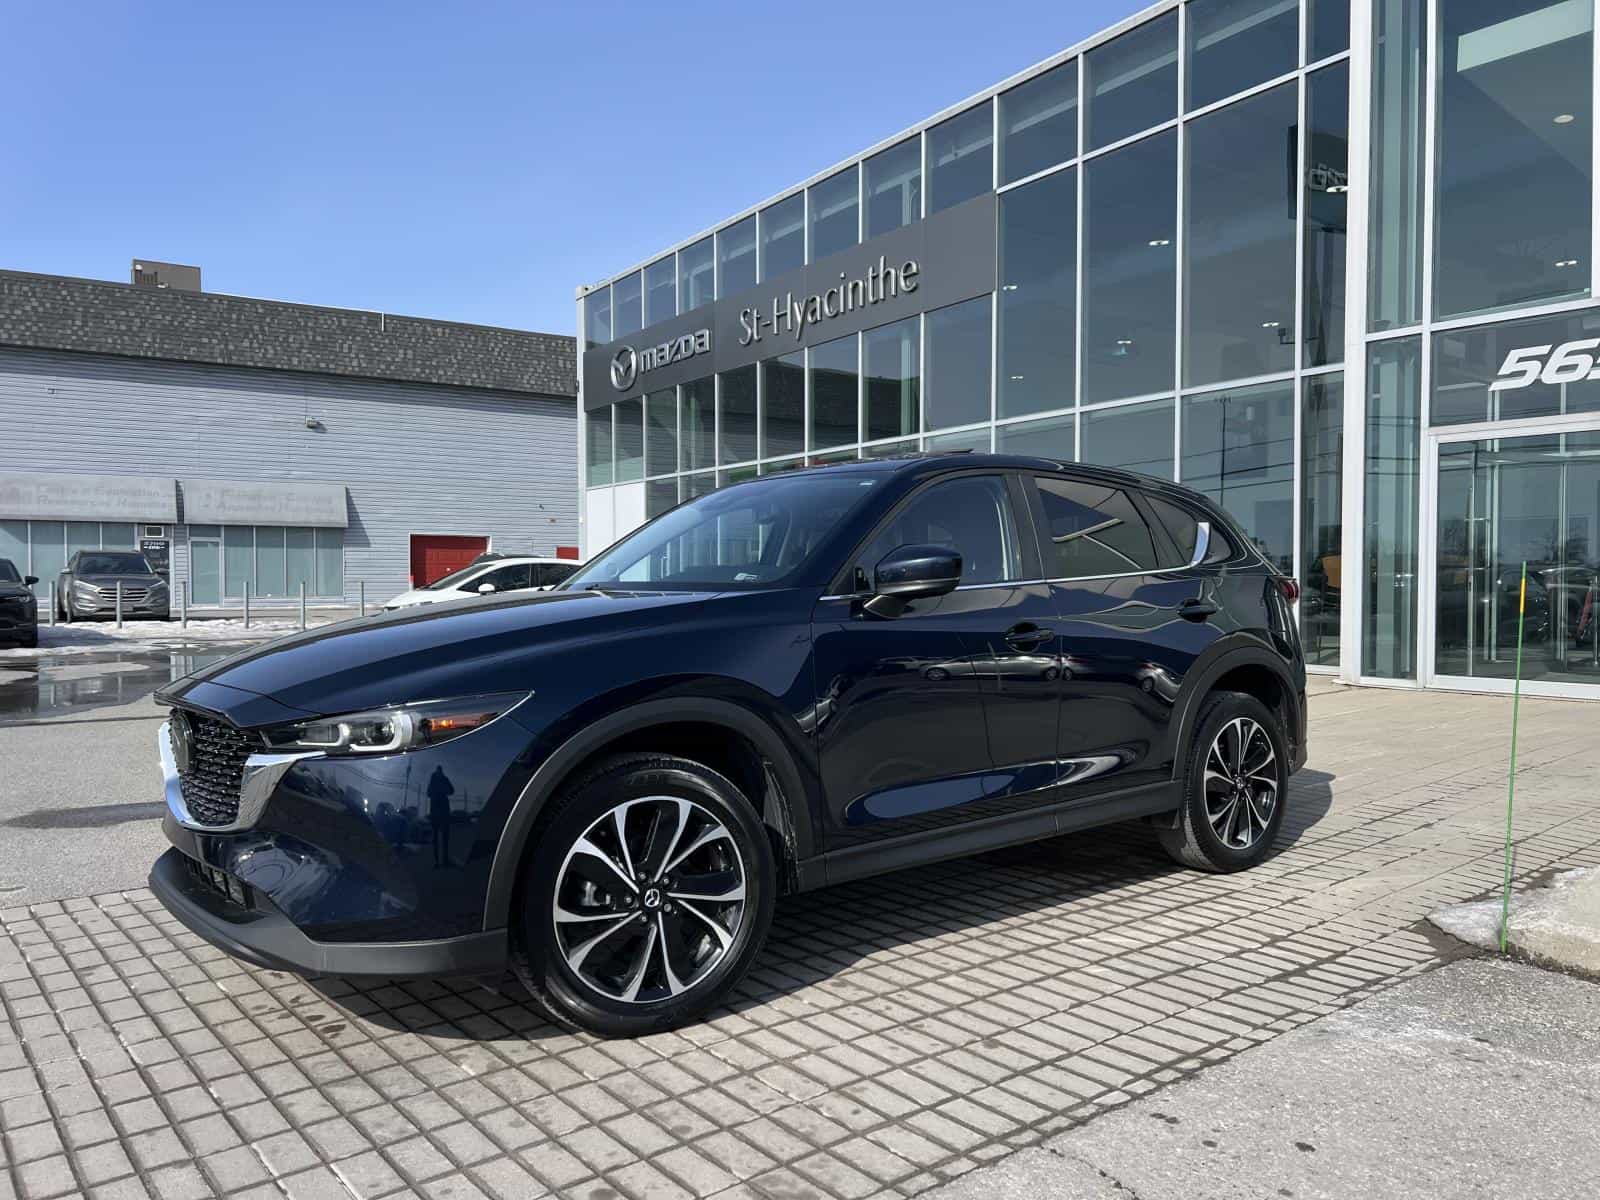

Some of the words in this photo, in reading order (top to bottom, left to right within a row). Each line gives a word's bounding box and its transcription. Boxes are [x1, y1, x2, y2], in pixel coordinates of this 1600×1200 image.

[738, 255, 920, 346] St-Hyacinthe
[639, 329, 710, 373] mazda
[1488, 338, 1600, 391] 56
